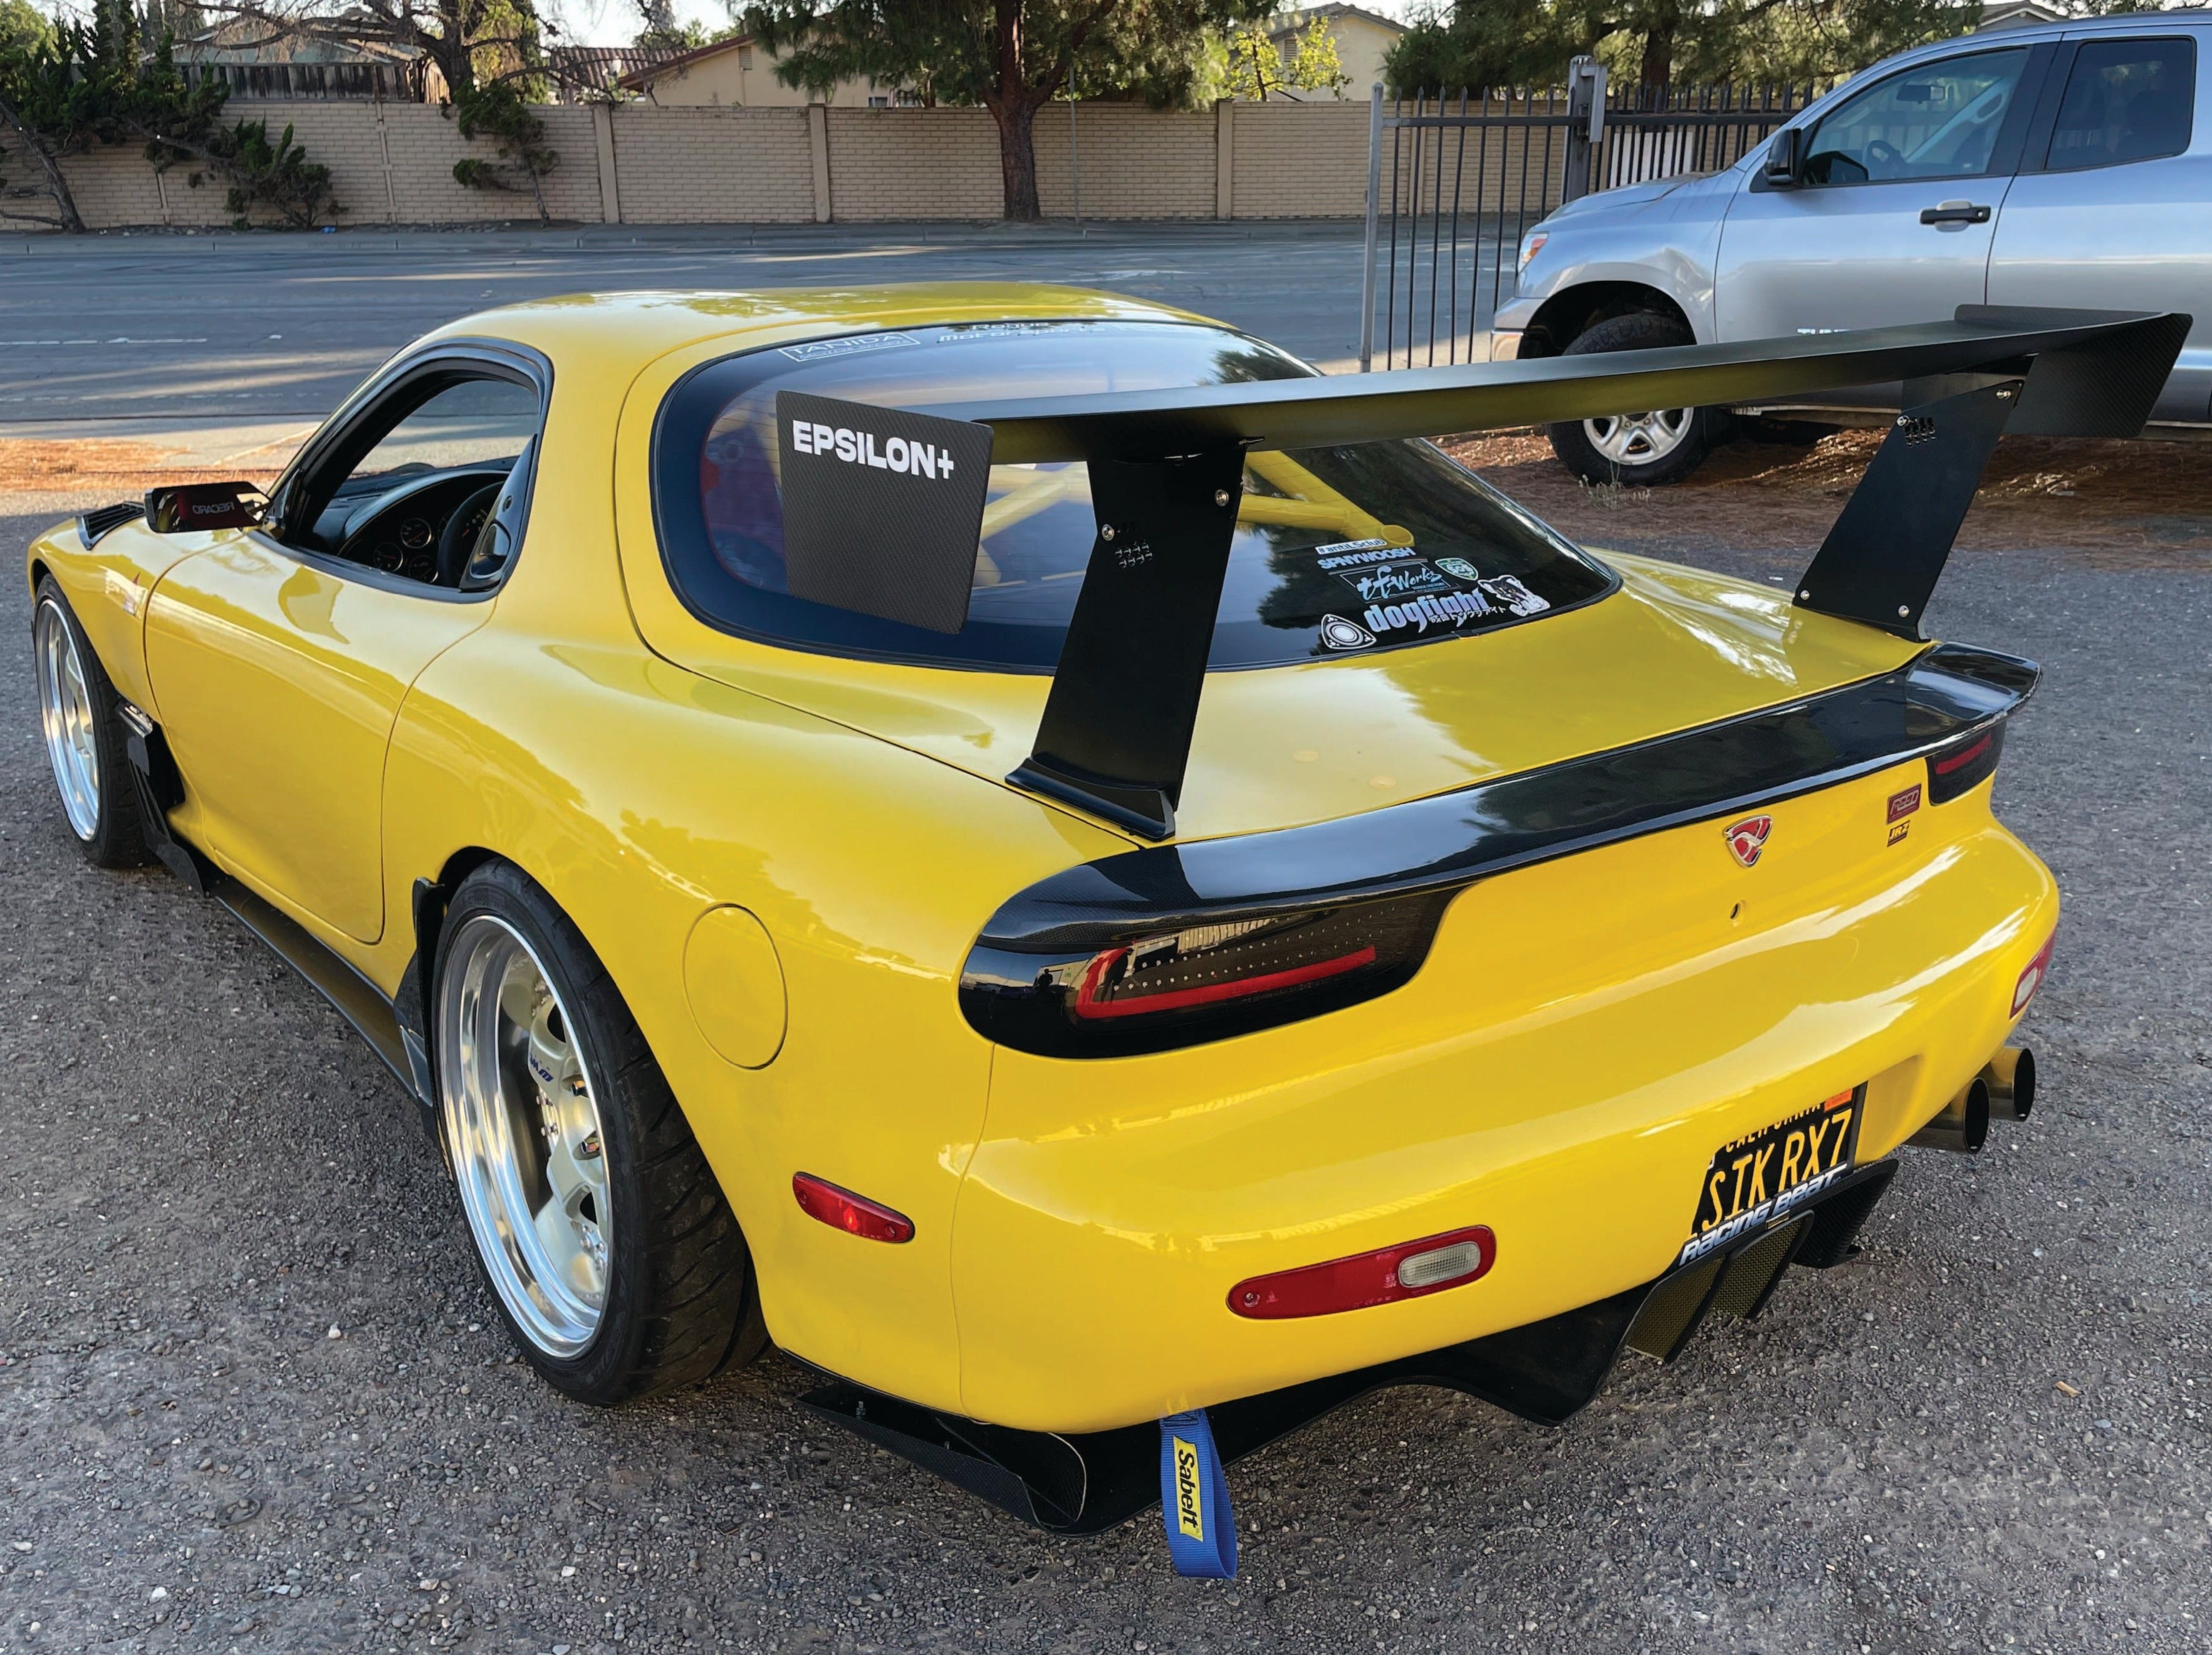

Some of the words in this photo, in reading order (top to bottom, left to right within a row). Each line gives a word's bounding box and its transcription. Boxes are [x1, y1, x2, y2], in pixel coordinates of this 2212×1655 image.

[786, 335, 904, 354] TANIDA
[793, 419, 954, 480] EPSILON+
[1364, 587, 1490, 633] dogfight
[1889, 821, 1910, 840] JRZ
[1778, 1108, 1852, 1192] RX7
[1179, 1449, 1198, 1528] Sabelt
